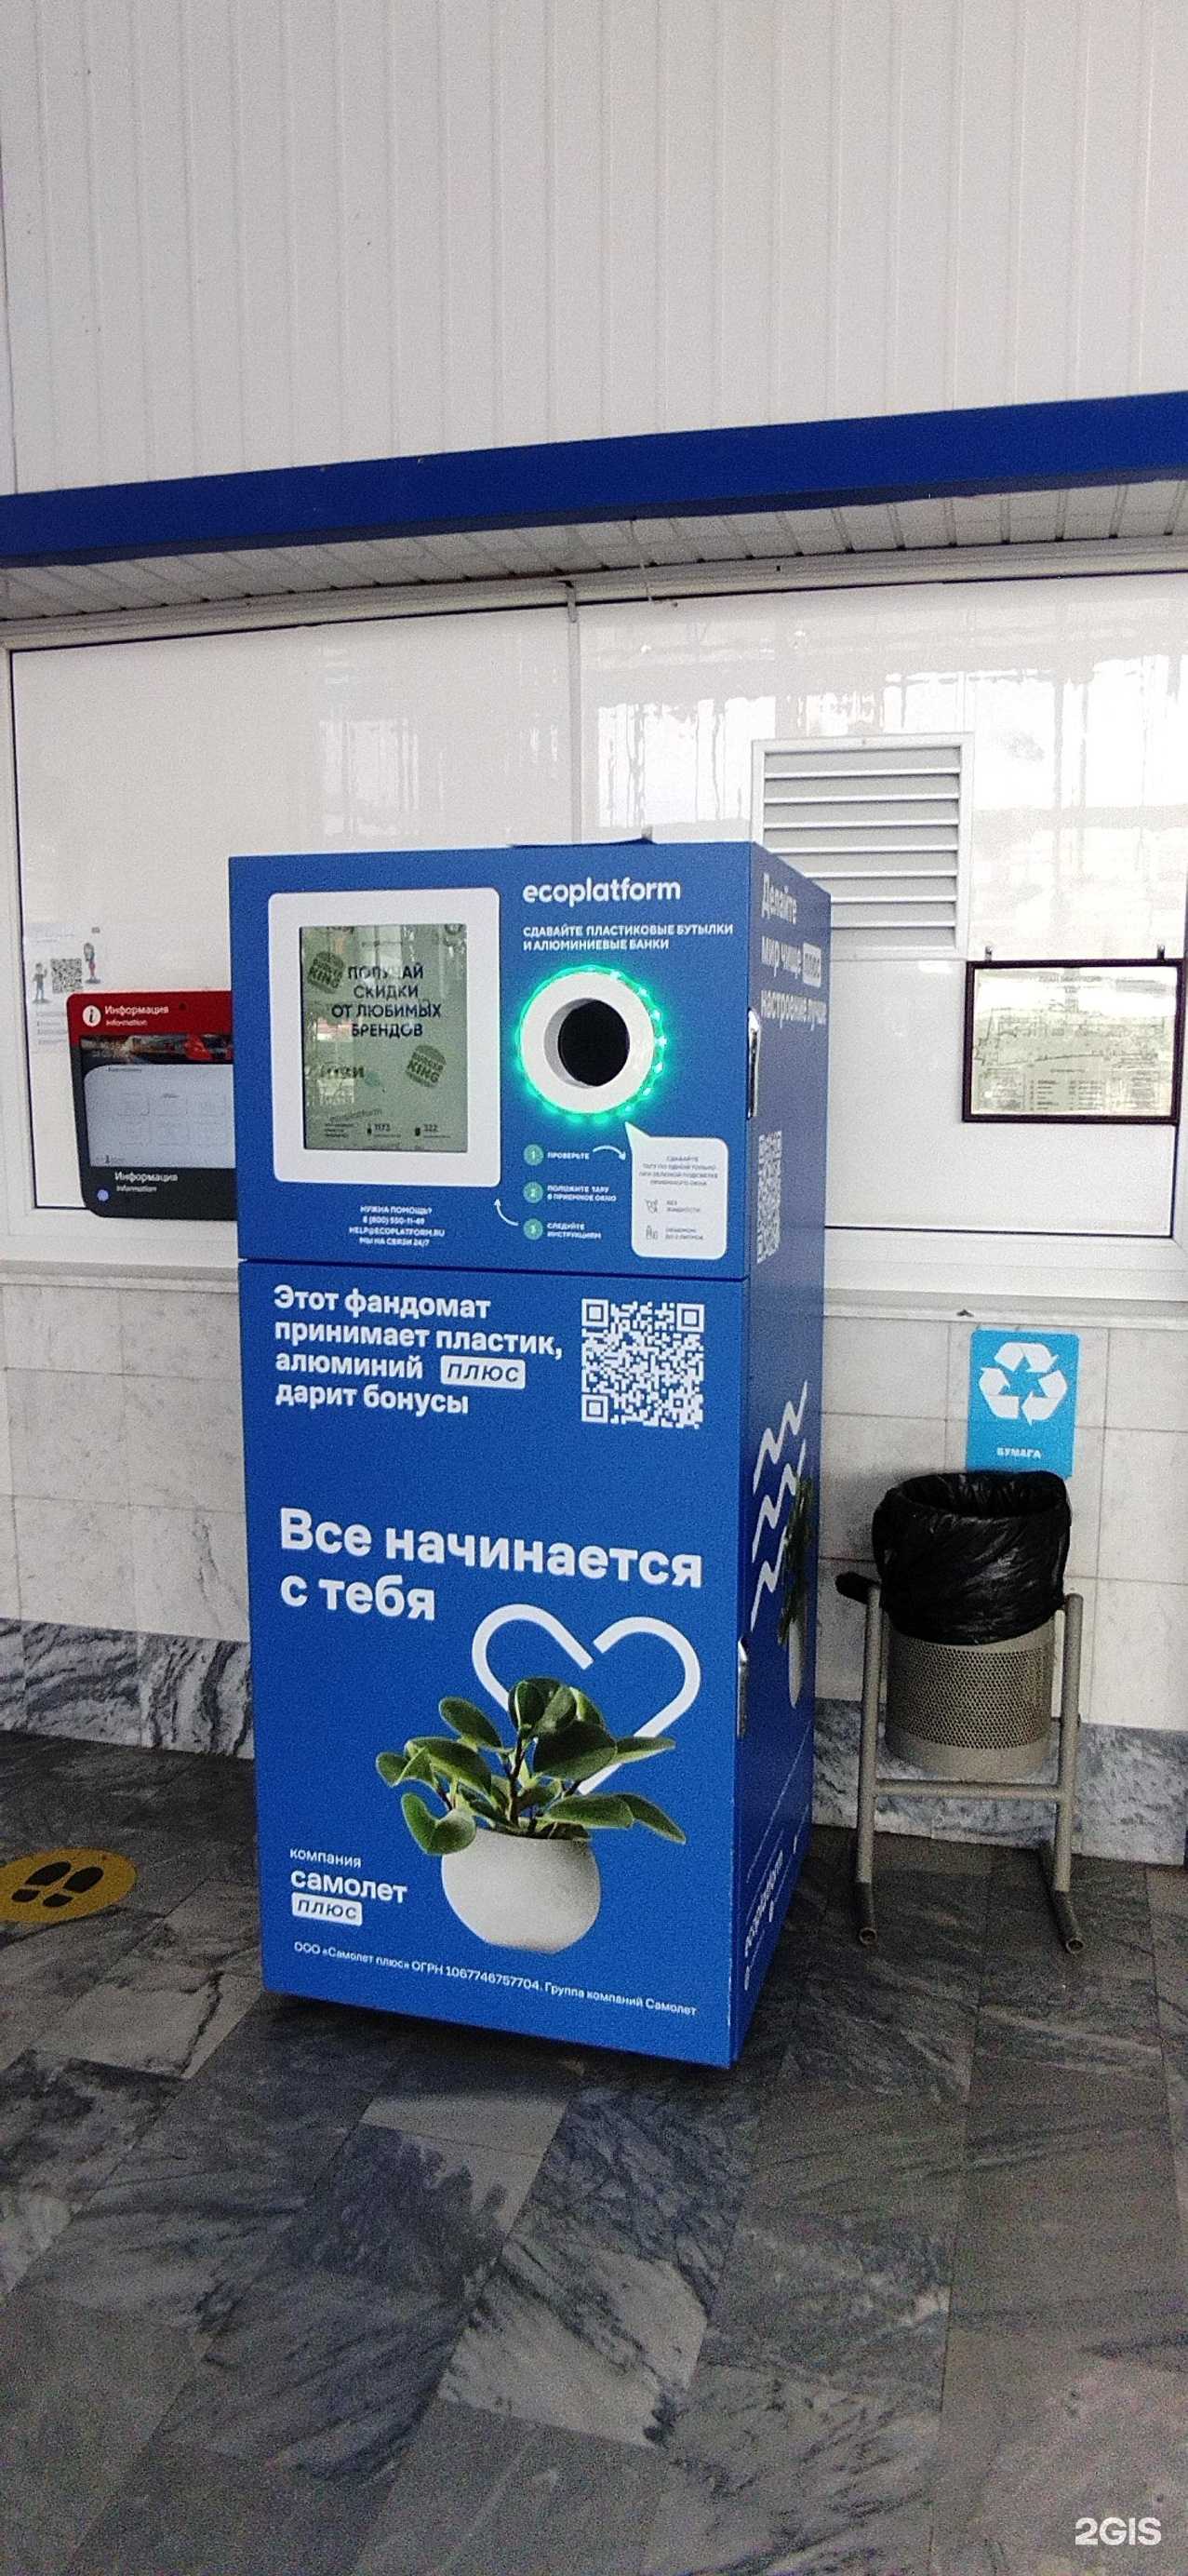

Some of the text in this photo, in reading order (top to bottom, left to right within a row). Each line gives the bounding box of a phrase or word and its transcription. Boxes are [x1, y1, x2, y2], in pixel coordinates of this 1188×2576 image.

[522, 877, 681, 907] ecoplatform
[523, 923, 733, 937] СДАВАЙТЕ ПЛАСТИКОВЫЕ БУТЫЛКИ
[523, 938, 669, 950] И АЛЮМИНИЕВЫЕ БАНКИ
[354, 985, 419, 1000] СКИДКИ
[104, 1005, 169, 1017] Информация
[331, 1003, 442, 1018] ОТ ЛЮБИМЫХ
[352, 1023, 423, 1038] БРЕНДОВ
[407, 1059, 440, 1083] KING
[114, 1171, 179, 1183] Информация
[391, 1206, 433, 1214] ПОМОЩЬ?
[349, 1227, 446, 1237] HELP@ECOPLATFORM.RU
[413, 1239, 430, 1247] 24/7
[274, 1284, 491, 1319] Этот фандомат
[274, 1321, 564, 1361] принимает пластик,
[275, 1352, 423, 1379] алюминий
[275, 1383, 469, 1417] дарит бонусы
[996, 1447, 1042, 1459] БУМАГА
[280, 1507, 702, 1589] Все начинается
[281, 1575, 435, 1621] с тебя
[289, 1848, 362, 1869] компания
[290, 1870, 407, 1904] самолет
[294, 1940, 321, 1954] ООО
[323, 1946, 373, 1964] «Самолет
[376, 1956, 409, 1969] плюс»
[411, 1961, 444, 1975] ОГРН
[544, 1981, 585, 1998] Группа
[587, 1991, 644, 2007] компаний
[645, 1997, 697, 2017] Самолет
